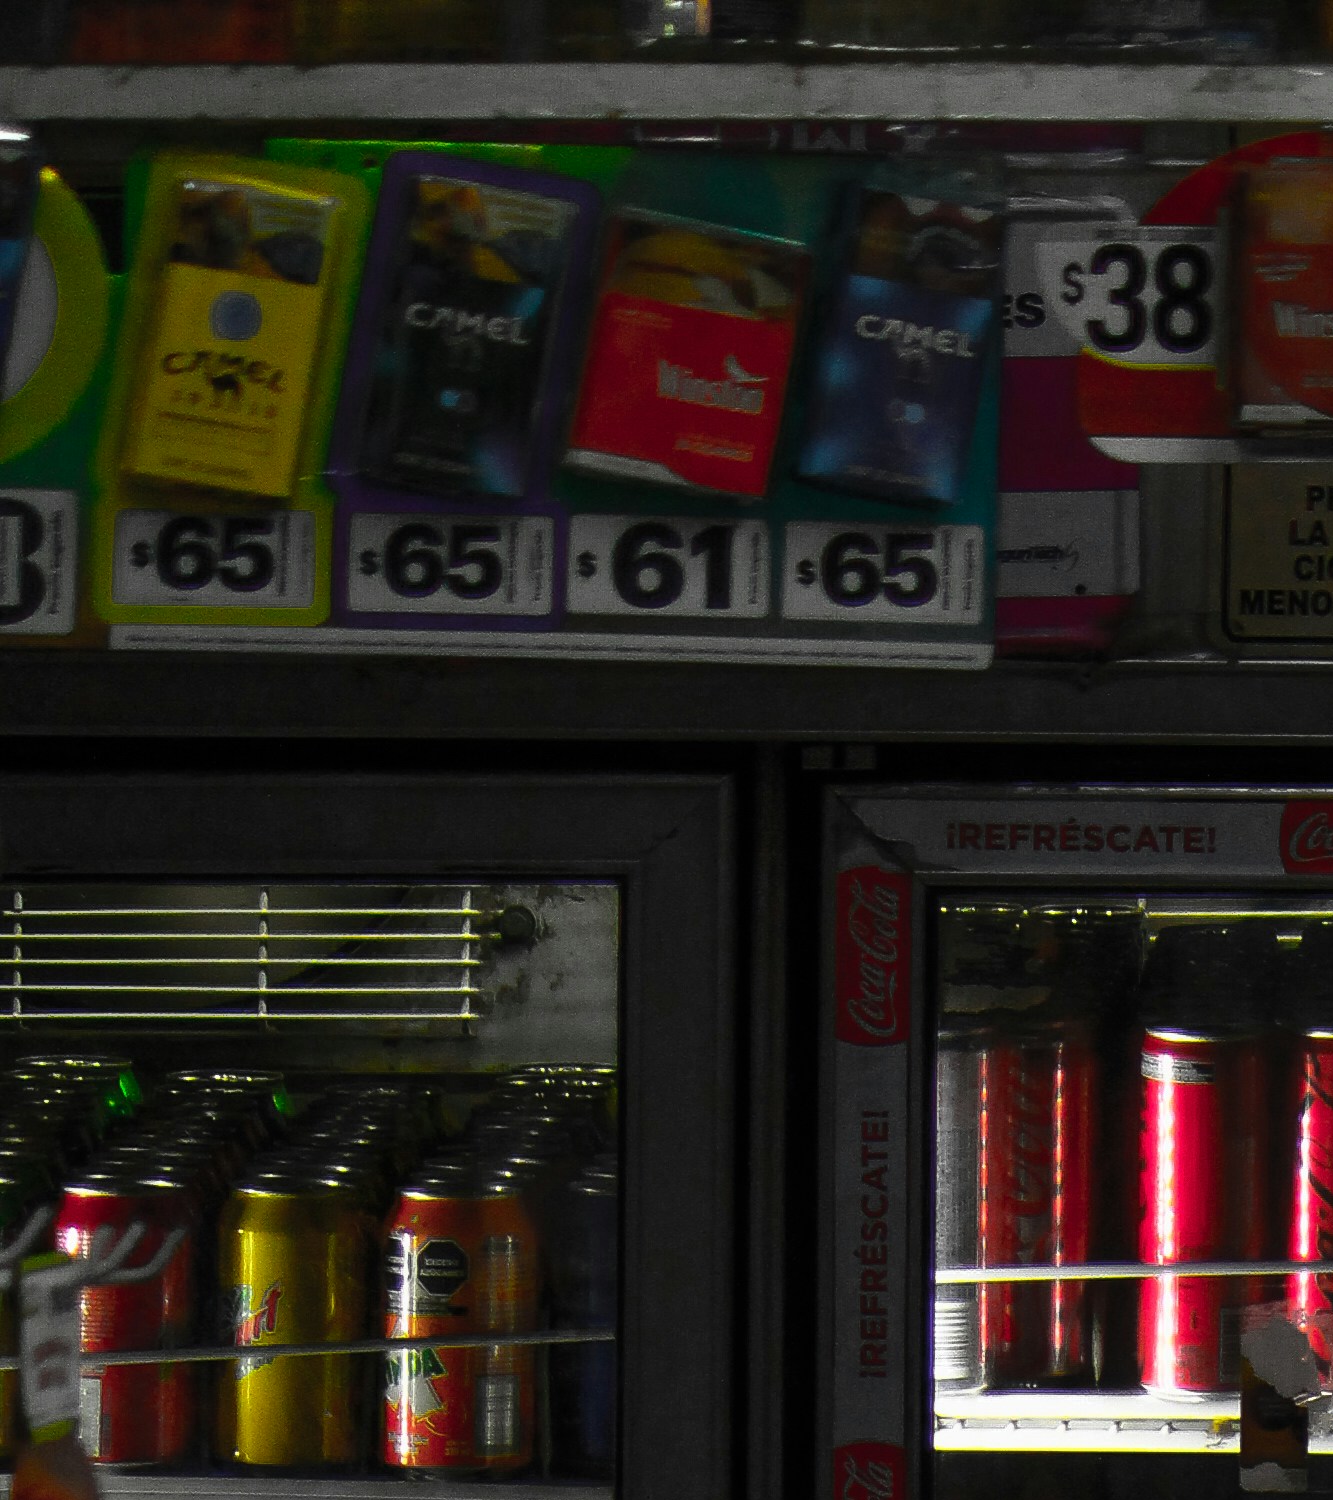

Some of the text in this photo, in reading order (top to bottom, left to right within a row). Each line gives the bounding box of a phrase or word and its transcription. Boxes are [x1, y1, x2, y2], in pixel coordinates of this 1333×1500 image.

[404, 302, 531, 345] CAMEL
[855, 314, 975, 359] CAMEL
[130, 516, 273, 592] $65
[360, 522, 501, 600] $65
[577, 521, 733, 610] $61
[796, 531, 938, 608] $65
[1288, 519, 1330, 547] LA
